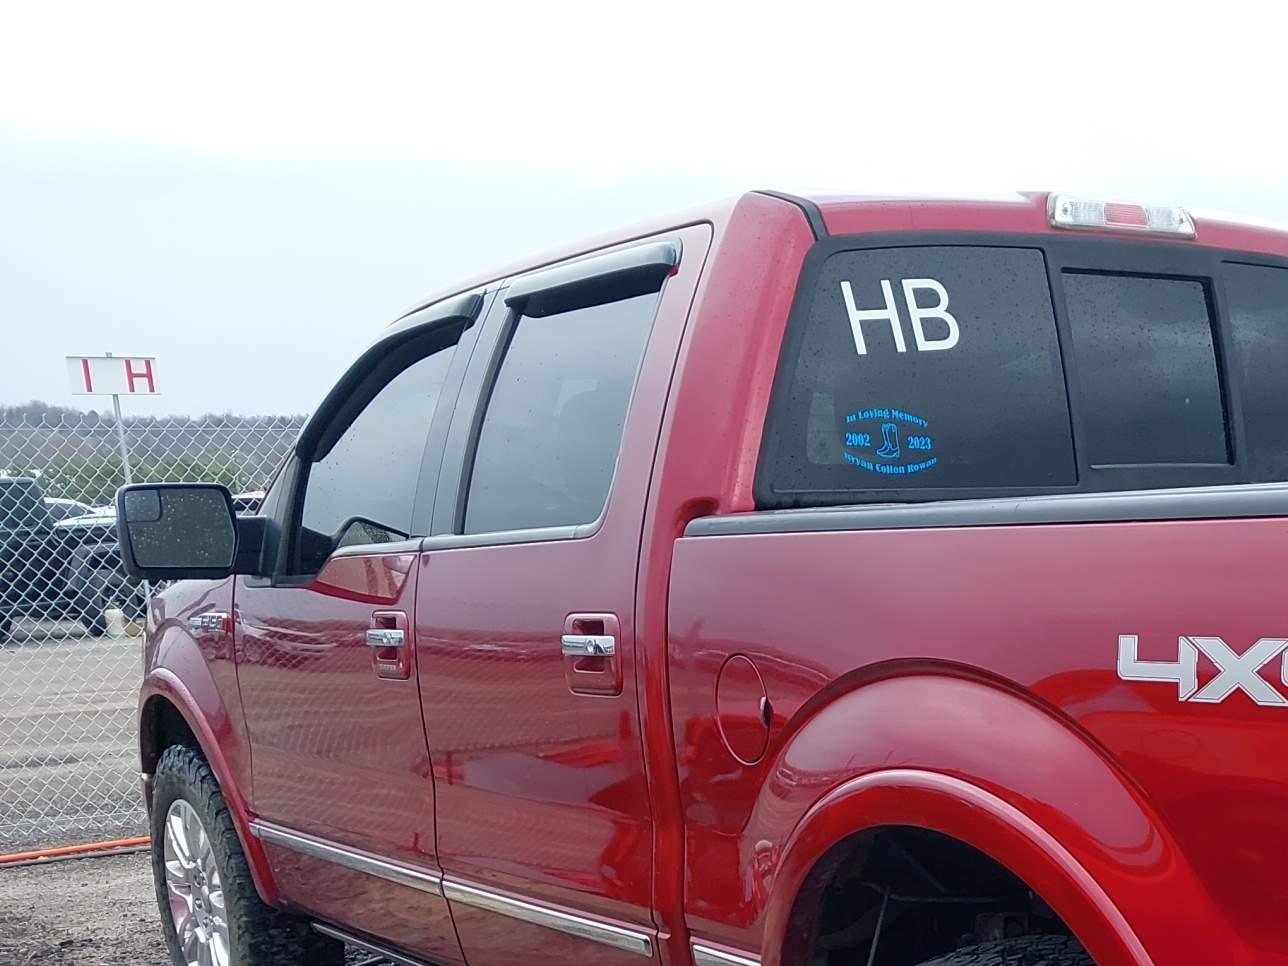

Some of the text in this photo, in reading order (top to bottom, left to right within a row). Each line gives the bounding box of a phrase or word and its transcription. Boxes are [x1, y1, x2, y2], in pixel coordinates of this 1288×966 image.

[840, 278, 960, 355] HB
[124, 359, 155, 393] H
[858, 408, 890, 420] Loving
[891, 408, 929, 428] Memory
[845, 432, 932, 450] 2002 2023
